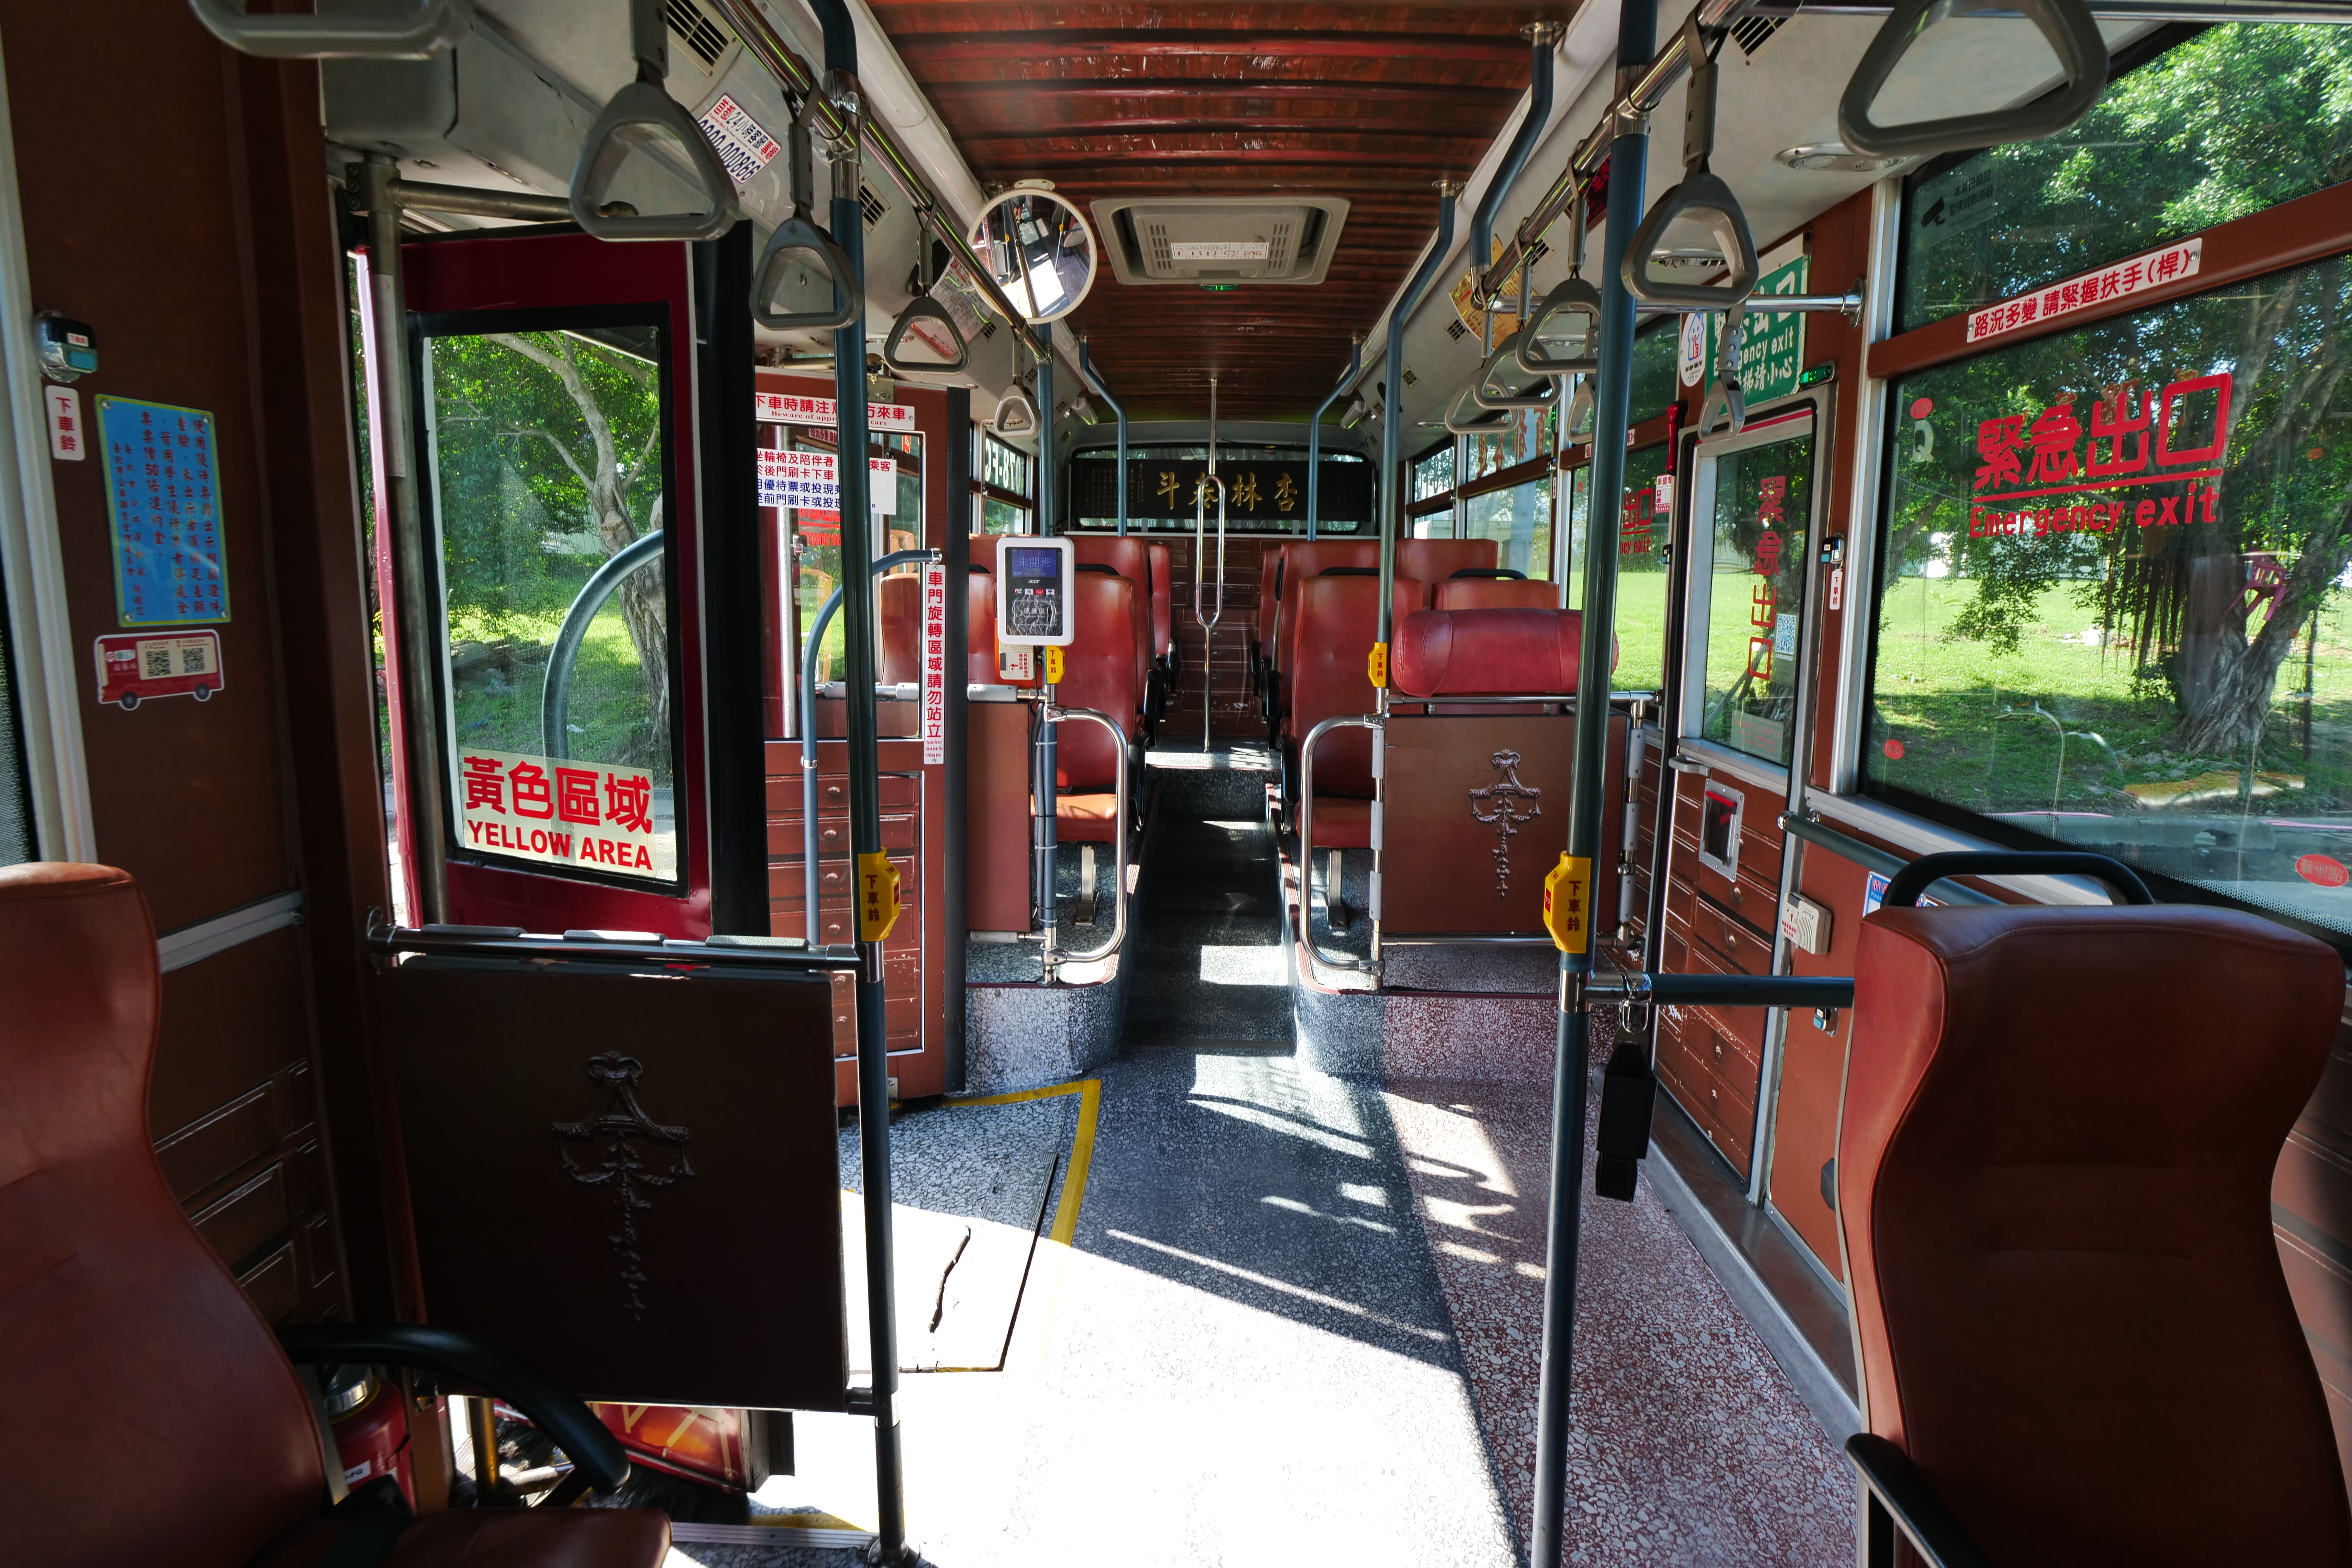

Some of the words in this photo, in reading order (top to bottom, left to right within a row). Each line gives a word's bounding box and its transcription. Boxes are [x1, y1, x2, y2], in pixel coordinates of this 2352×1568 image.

[1974, 297, 2038, 339] 路況多變
[2043, 249, 2190, 317] 請緊握扶手(桿)
[1772, 326, 1793, 355] exit
[1734, 356, 1792, 396] 梯請小心
[55, 397, 76, 451] 下車鈴
[772, 411, 804, 419] Beware
[1974, 372, 2233, 490] 緊急出口
[1623, 488, 1653, 529] 出口
[1970, 501, 2125, 538] Emergency
[2135, 482, 2220, 528] exit
[1018, 556, 1051, 568] 未開班
[1633, 534, 1651, 553] exit
[1750, 475, 1786, 680] 緊急出口
[926, 571, 943, 738] 車門旋轉區域請勿站立
[463, 756, 653, 834] 黃色區域
[466, 819, 572, 858] YELLOW
[580, 837, 653, 871] AREA
[866, 875, 880, 922] 下車鈴
[1567, 880, 1582, 932] 下車鈴
[1871, 891, 1882, 901] Pleas
